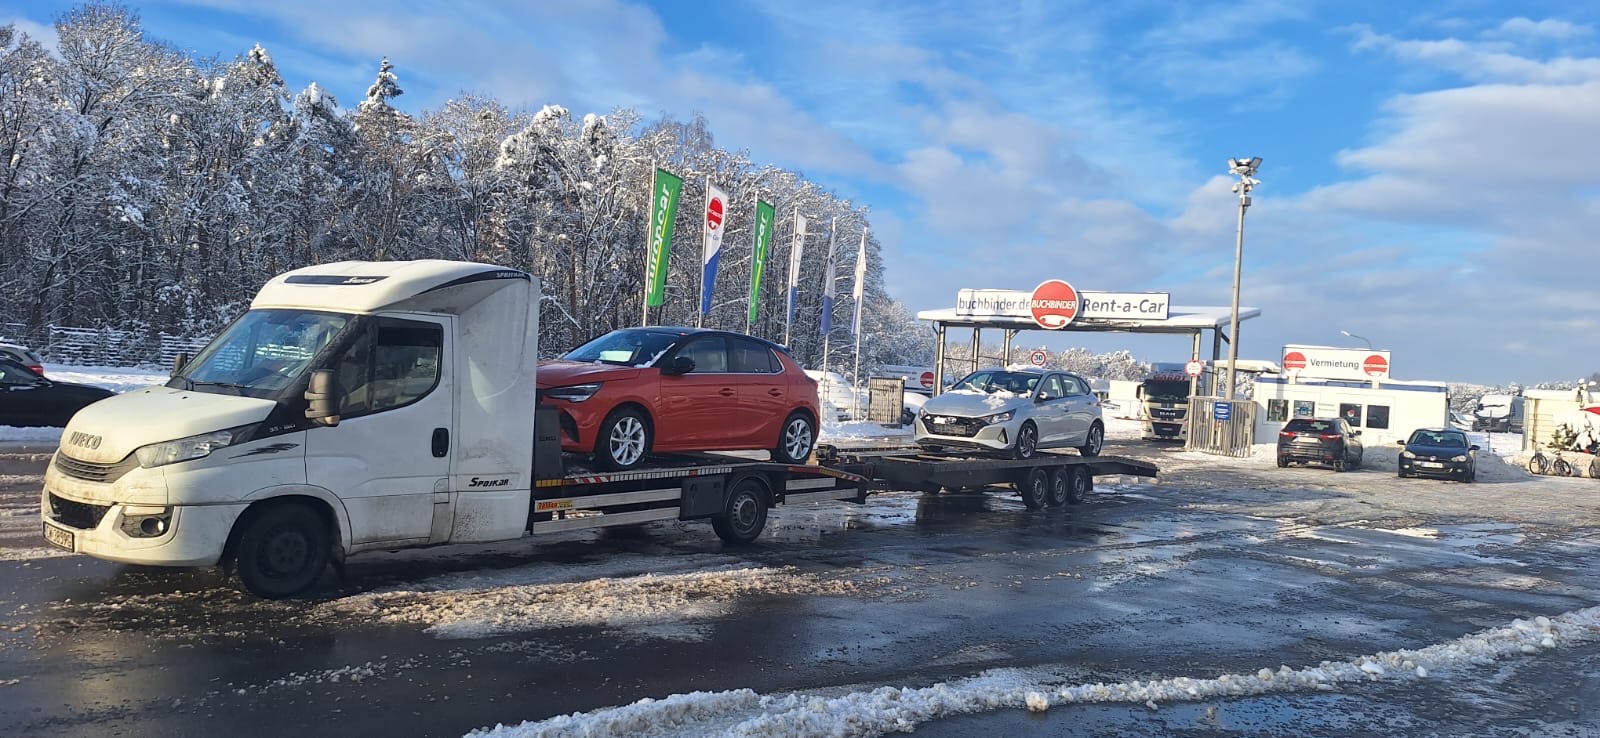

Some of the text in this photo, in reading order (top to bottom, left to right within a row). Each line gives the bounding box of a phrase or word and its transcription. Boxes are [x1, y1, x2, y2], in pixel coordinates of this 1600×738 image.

[958, 297, 1031, 311] buchbinder.de
[1032, 298, 1076, 310] BUCHBINDER
[1083, 298, 1165, 313] Rent-a-Car
[1310, 358, 1360, 370] Vermietung
[70, 431, 103, 450] IVECO
